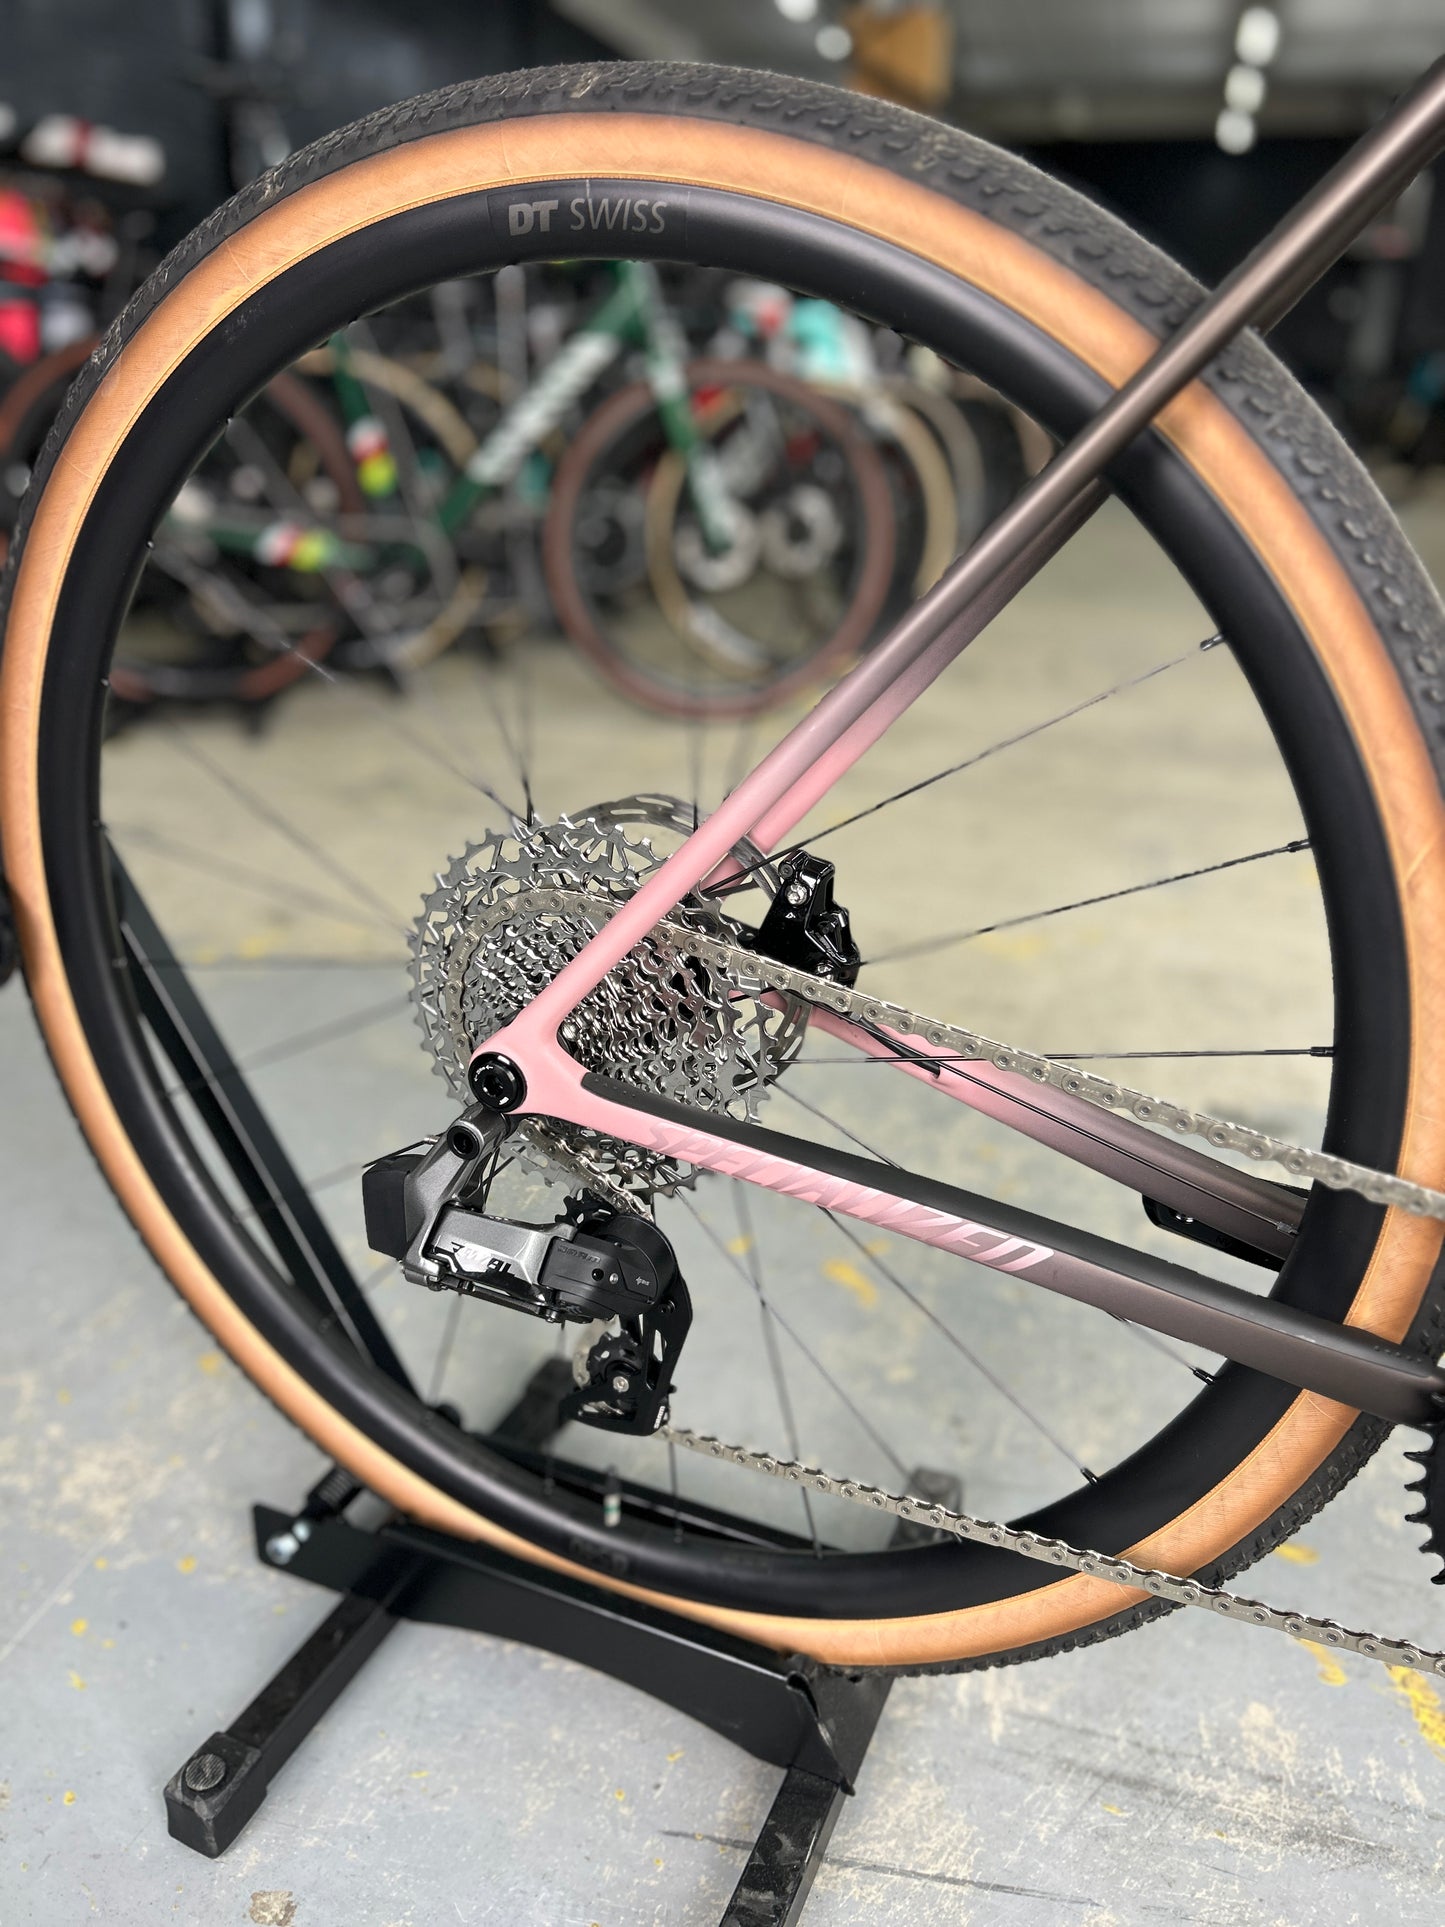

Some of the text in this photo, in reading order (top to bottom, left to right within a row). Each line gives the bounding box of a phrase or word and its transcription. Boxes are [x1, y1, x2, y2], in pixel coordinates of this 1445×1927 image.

[508, 198, 668, 236] DT SWISS
[645, 1121, 1055, 1272] SPECIALIZED
